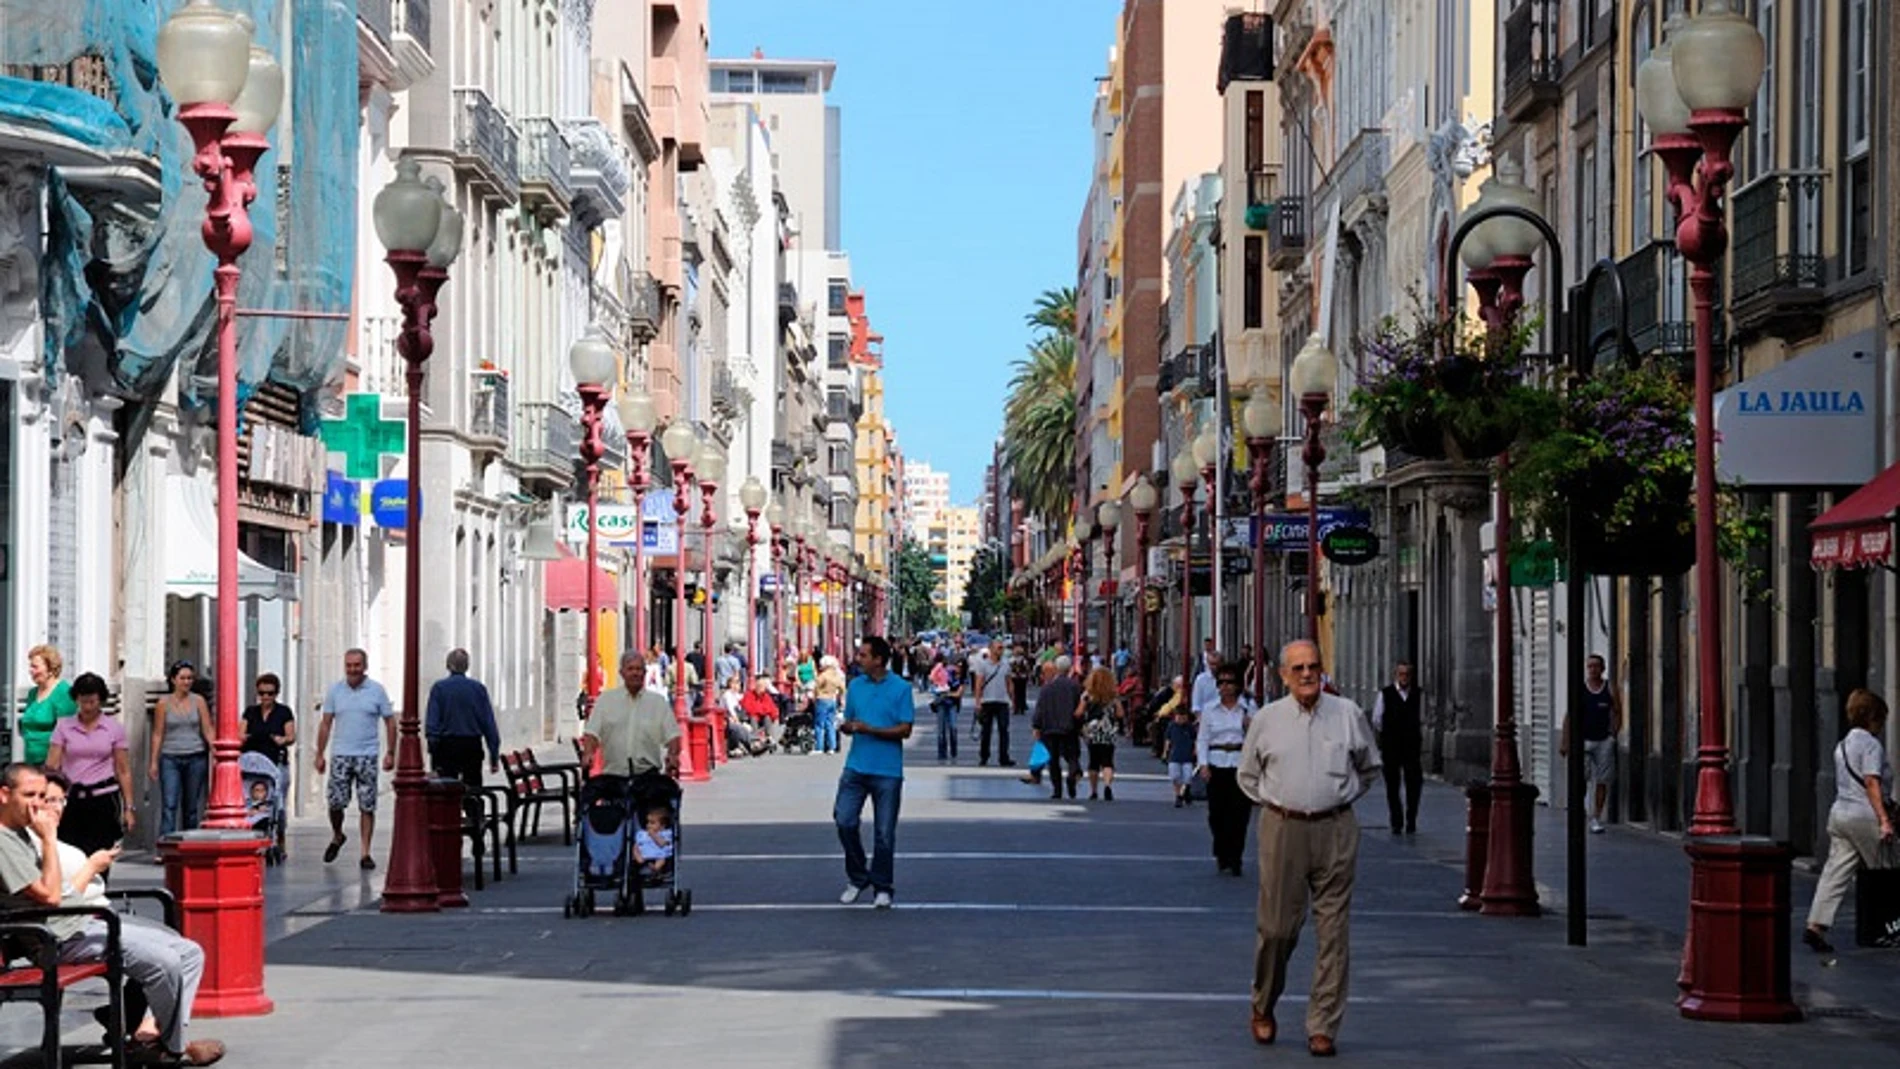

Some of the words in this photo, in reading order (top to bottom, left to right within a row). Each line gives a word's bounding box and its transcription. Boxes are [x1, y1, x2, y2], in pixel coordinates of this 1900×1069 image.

[1738, 391, 1773, 412] LA
[1779, 391, 1865, 412] JAULA
[569, 508, 638, 532] Rcasa
